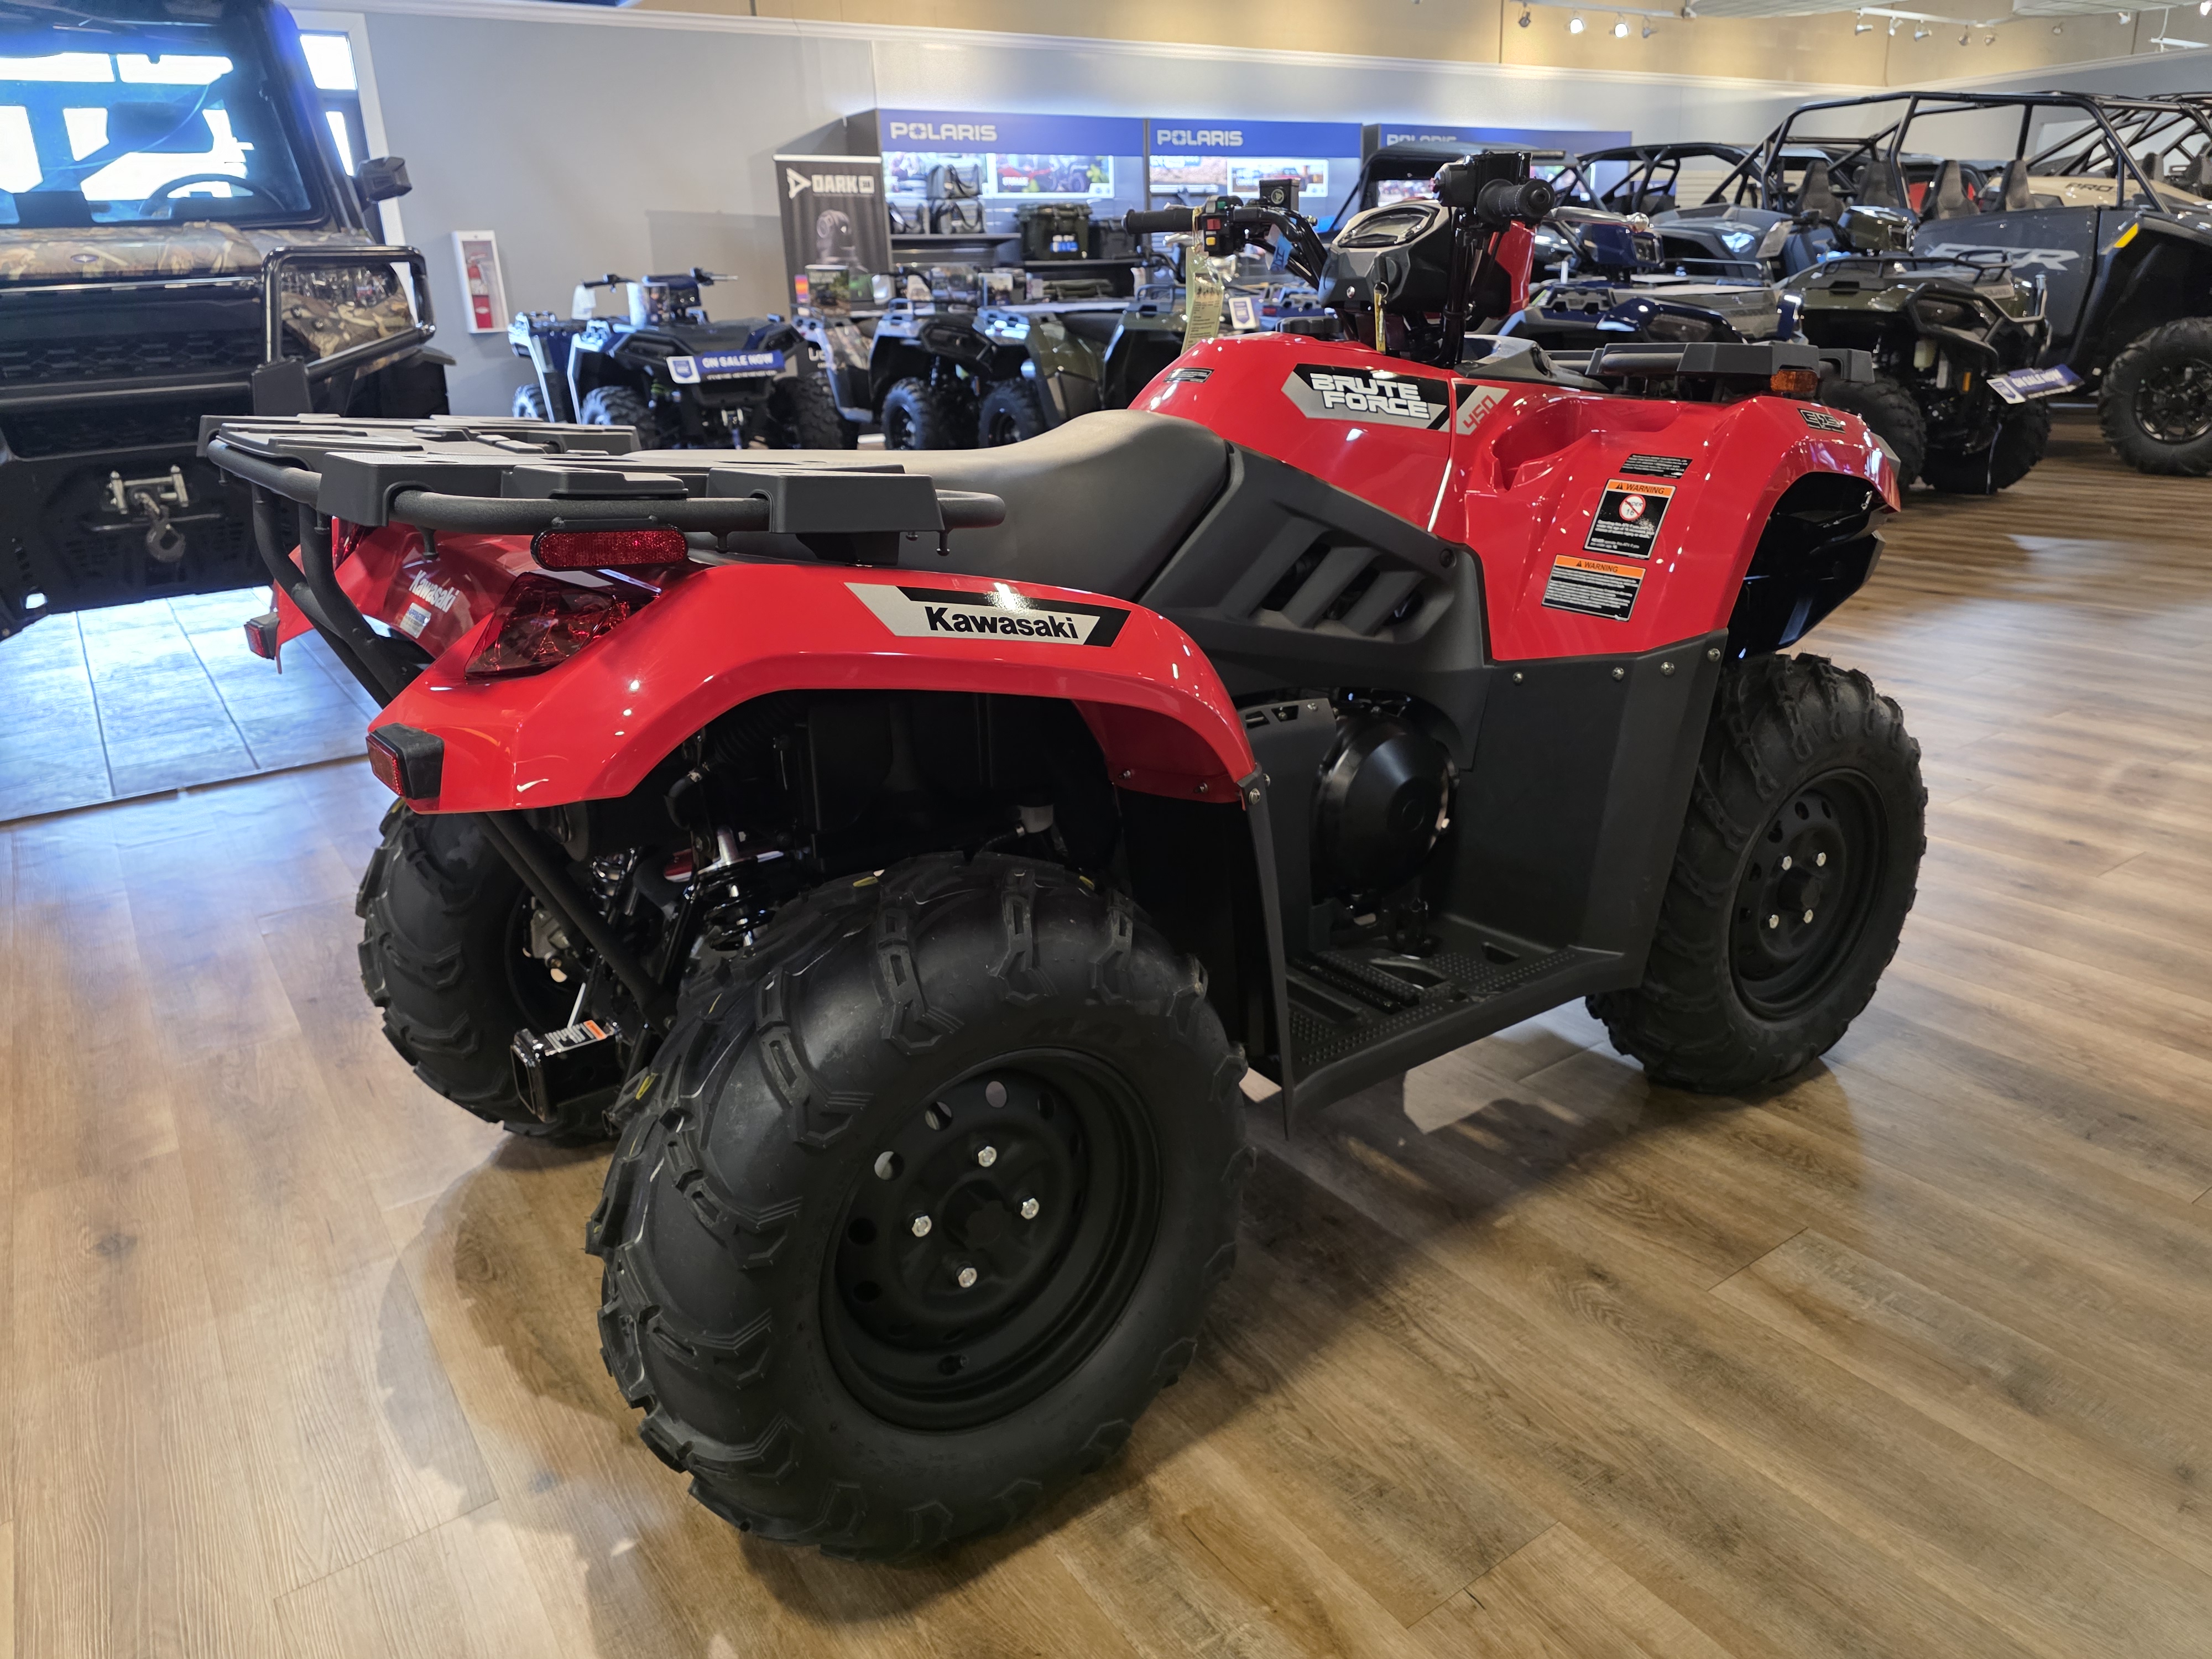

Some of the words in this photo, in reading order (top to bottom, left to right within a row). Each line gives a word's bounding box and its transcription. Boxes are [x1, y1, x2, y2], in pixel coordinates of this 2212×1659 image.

[890, 121, 998, 142] POLARIS
[1157, 129, 1244, 147] POLARIS
[811, 174, 858, 194] DARK
[702, 357, 719, 369] ON
[719, 354, 749, 368] SALE
[748, 352, 774, 366] NOW
[1310, 372, 1421, 401] BRUTE
[1322, 390, 1431, 420] FORCE
[1463, 394, 1495, 430] 450
[1626, 483, 1665, 494] WARNING
[1584, 561, 1619, 573] WARNING
[409, 569, 460, 613] Kawasaki
[924, 606, 1079, 639] Kawasaki
